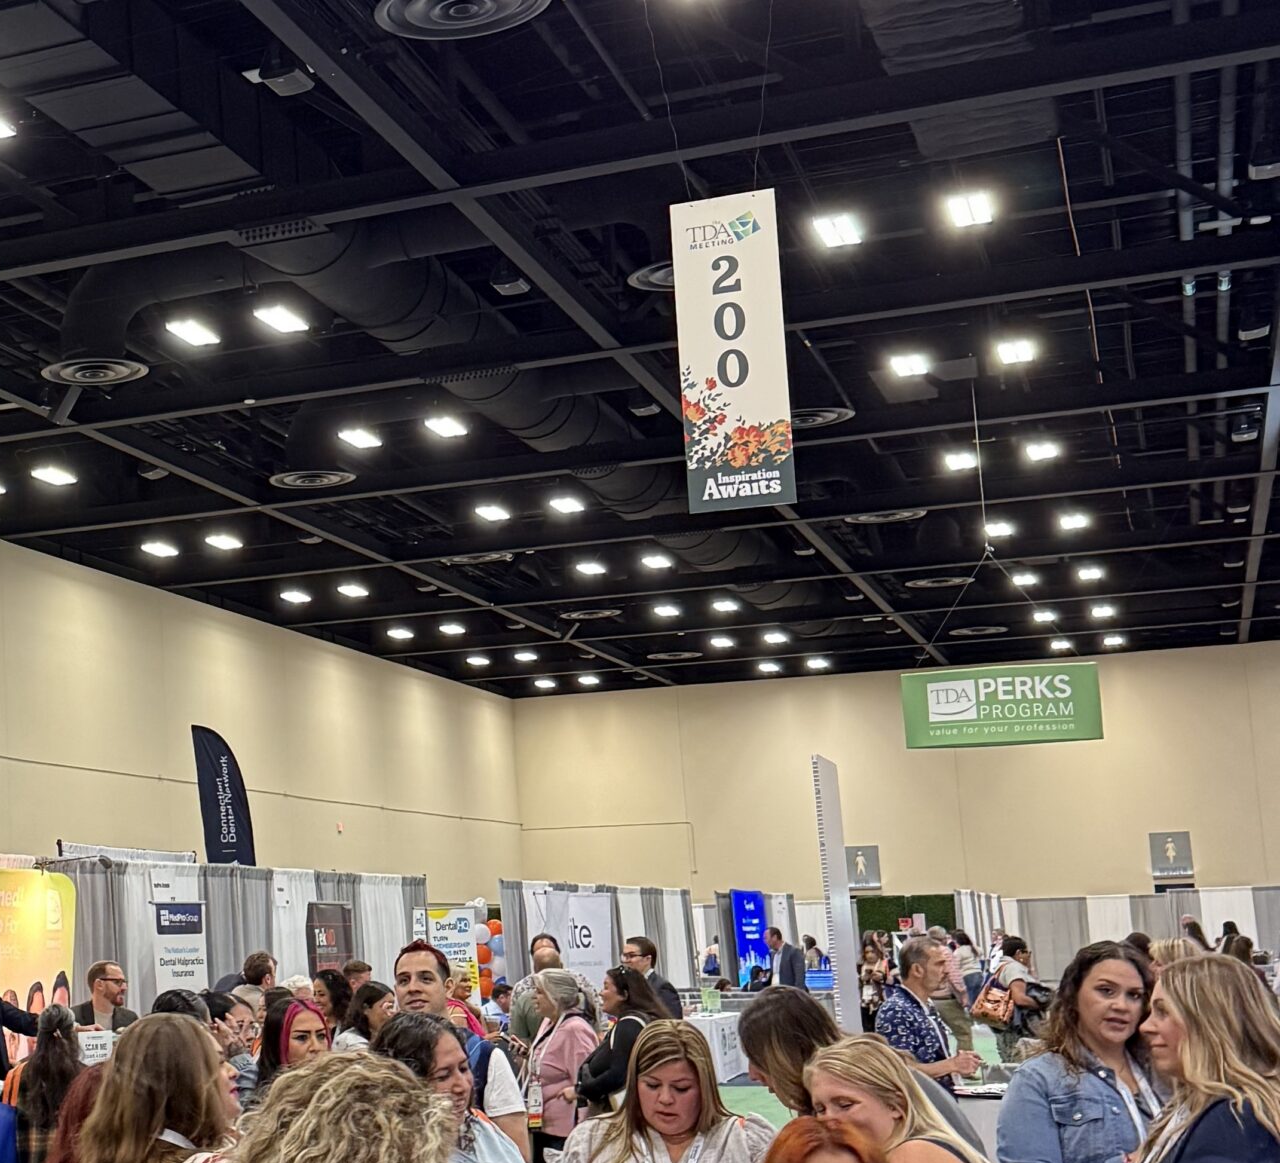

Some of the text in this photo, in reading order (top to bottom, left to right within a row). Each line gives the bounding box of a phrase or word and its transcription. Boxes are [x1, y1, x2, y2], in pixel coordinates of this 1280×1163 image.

[685, 222, 731, 243] TDA
[689, 237, 734, 250] MEETING
[717, 468, 781, 486] Inspiration
[702, 477, 782, 501] Awaits
[930, 674, 1072, 705] TDA PERKS
[980, 702, 1074, 719] PROGRAM
[929, 722, 1075, 737] value for your profession
[220, 755, 237, 843] Dental Network
[216, 777, 229, 843] Connection
[160, 957, 177, 967] Dental
